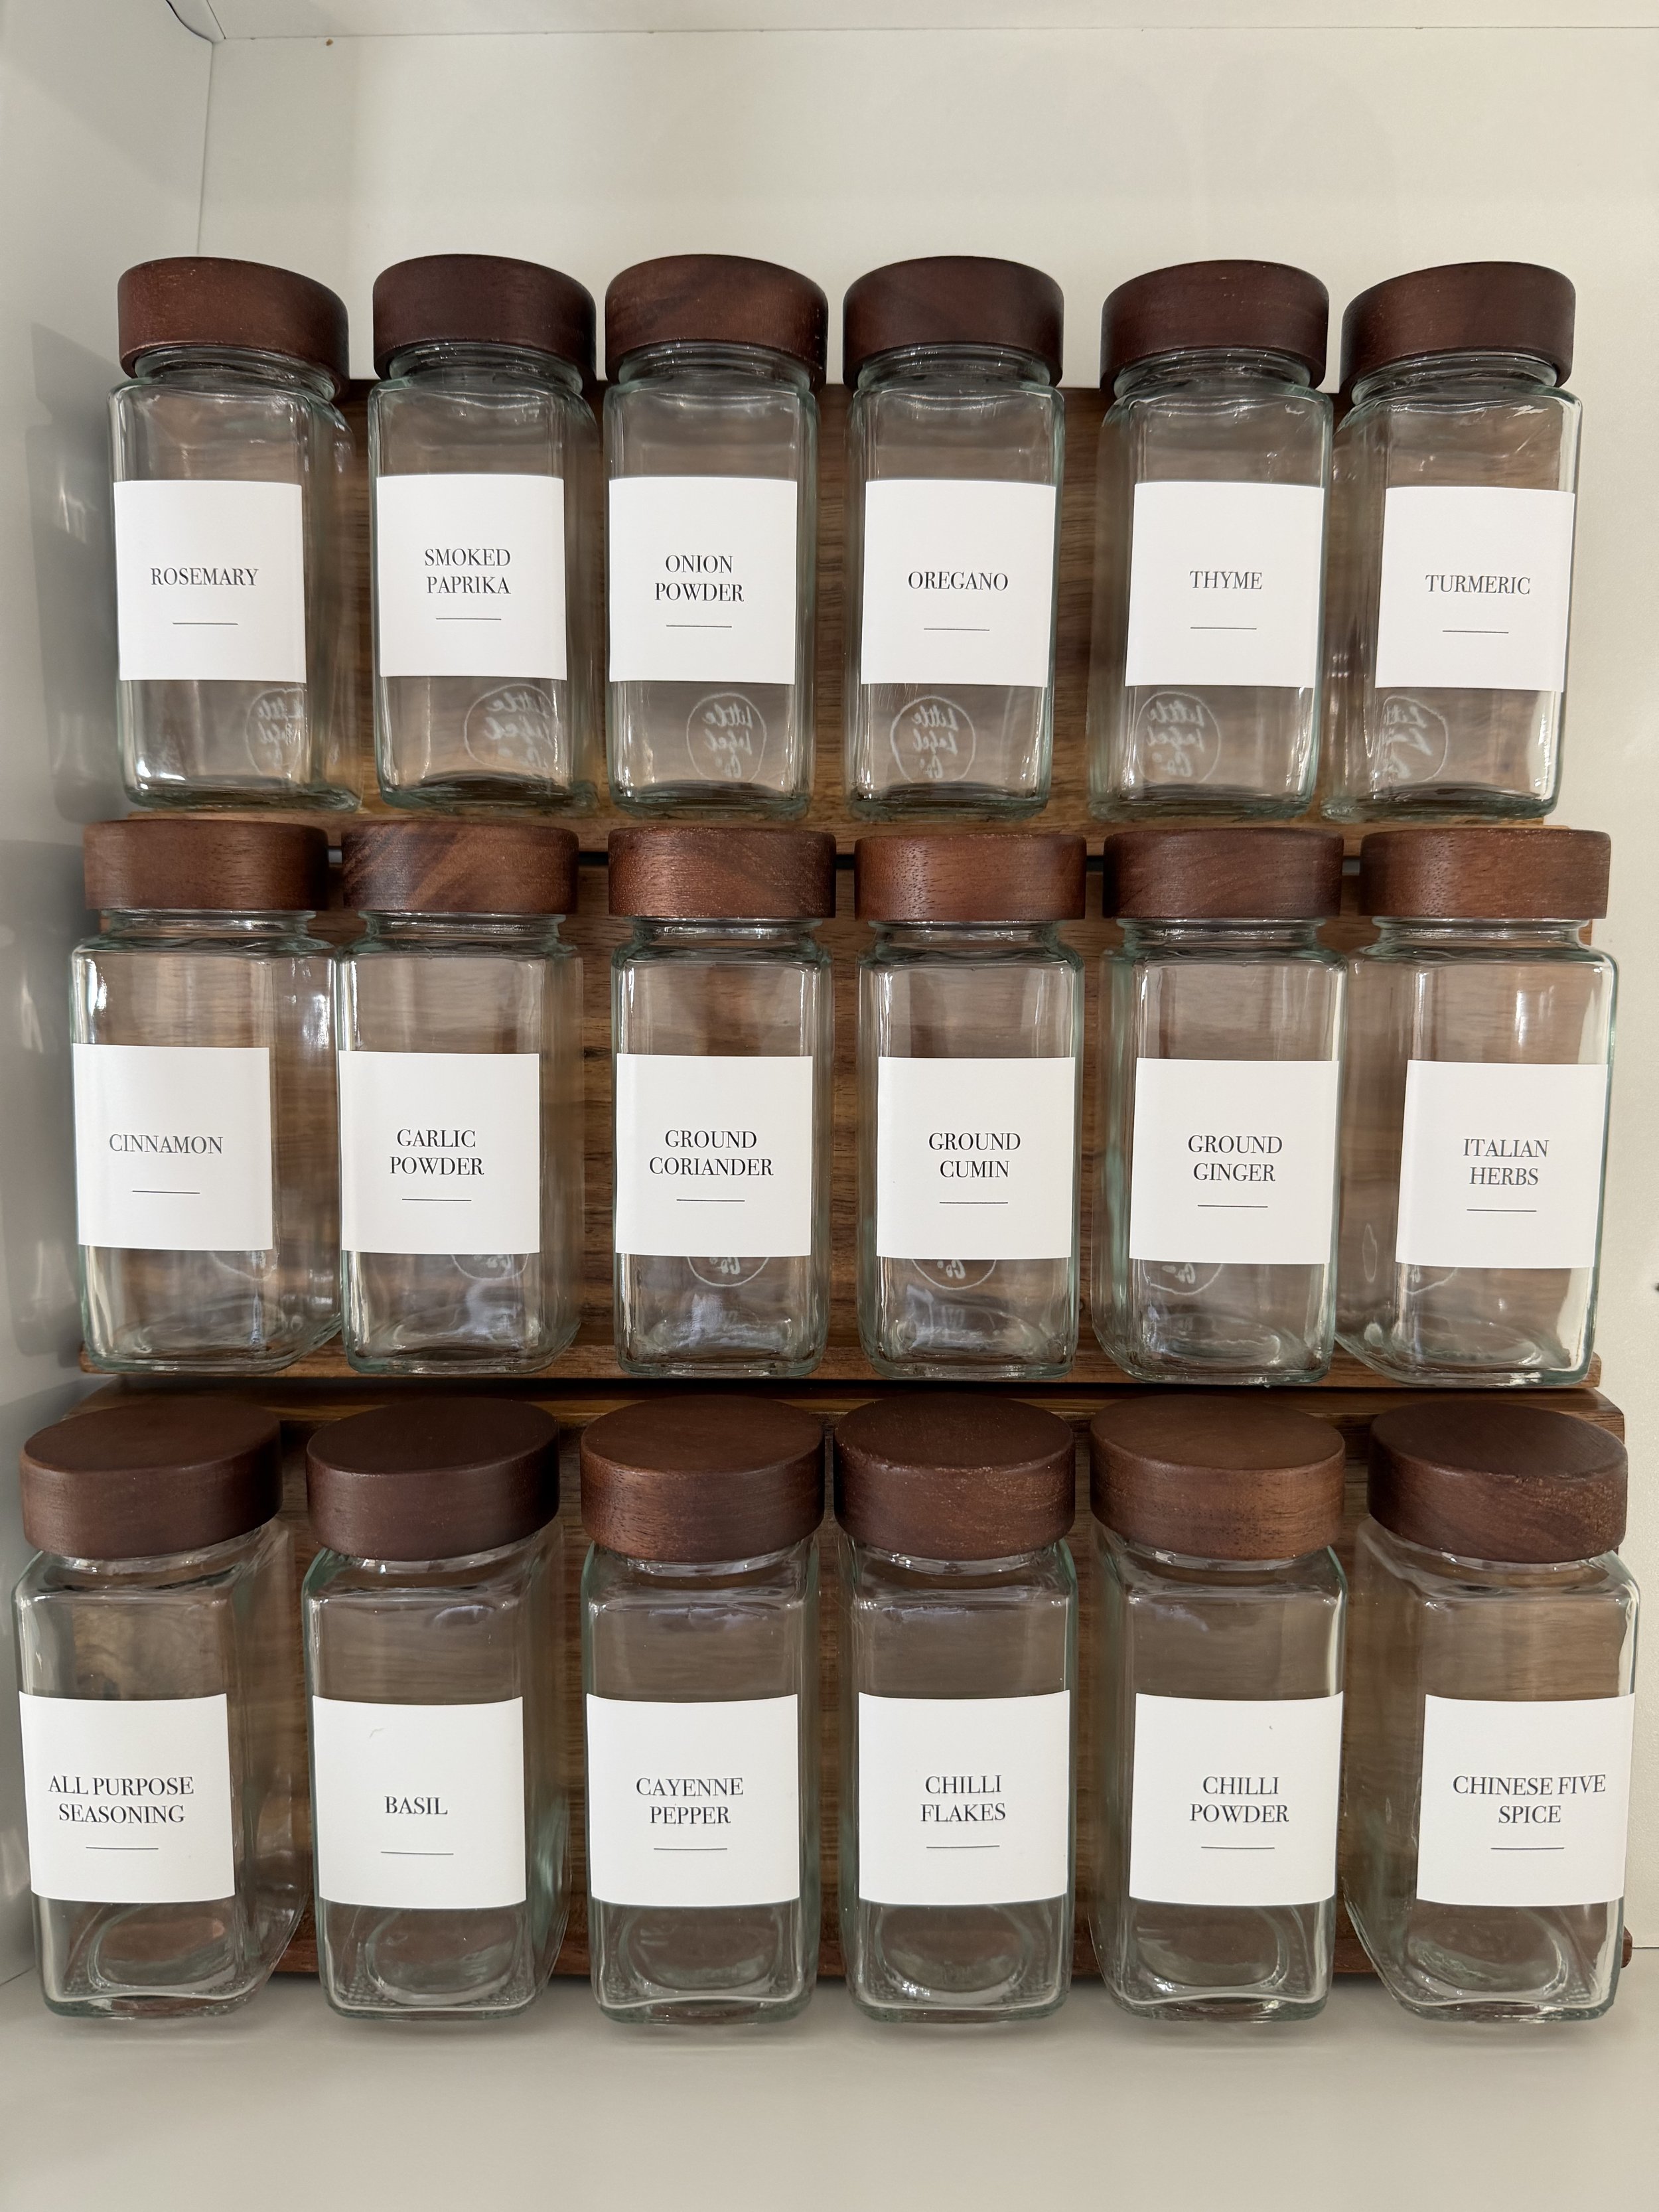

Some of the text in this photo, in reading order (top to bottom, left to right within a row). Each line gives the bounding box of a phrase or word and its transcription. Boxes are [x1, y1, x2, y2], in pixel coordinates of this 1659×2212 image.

[425, 548, 511, 567] SMOKED
[665, 554, 733, 573] ONION
[150, 567, 259, 586] ROSEMARY
[426, 575, 512, 595] PAPRIKA
[908, 571, 1009, 591] OREGANO
[1189, 570, 1262, 590] THYME
[1425, 574, 1531, 595] TURMERIC
[654, 582, 745, 603] POWDER
[109, 1134, 224, 1154] CINNAMON
[397, 1128, 476, 1148] GARLIC
[665, 1130, 757, 1149] GROUND
[928, 1132, 1021, 1151] GROUND
[1188, 1134, 1283, 1154] GROUND
[1463, 1138, 1550, 1157] ITALIAN
[389, 1156, 485, 1175] POWDER
[649, 1156, 774, 1176] CORIANDER
[940, 1160, 1010, 1178] CUMIN
[1193, 1162, 1276, 1182] GINGER
[1469, 1167, 1539, 1186] HERBS
[47, 1775, 194, 1796] ALL PURPOSE
[636, 1777, 744, 1797] CAYENNE
[925, 1774, 1002, 1795] CHILLI
[1202, 1776, 1279, 1795] CHILLI
[1453, 1774, 1606, 1796] CHINESE FIVE
[58, 1803, 186, 1824] SEASONING
[384, 1795, 448, 1815] BASIL
[920, 1803, 1006, 1822] FLAKES
[1189, 1803, 1289, 1823] POWDER
[1498, 1805, 1561, 1824] SPICE
[649, 1806, 731, 1825] PEPPER
